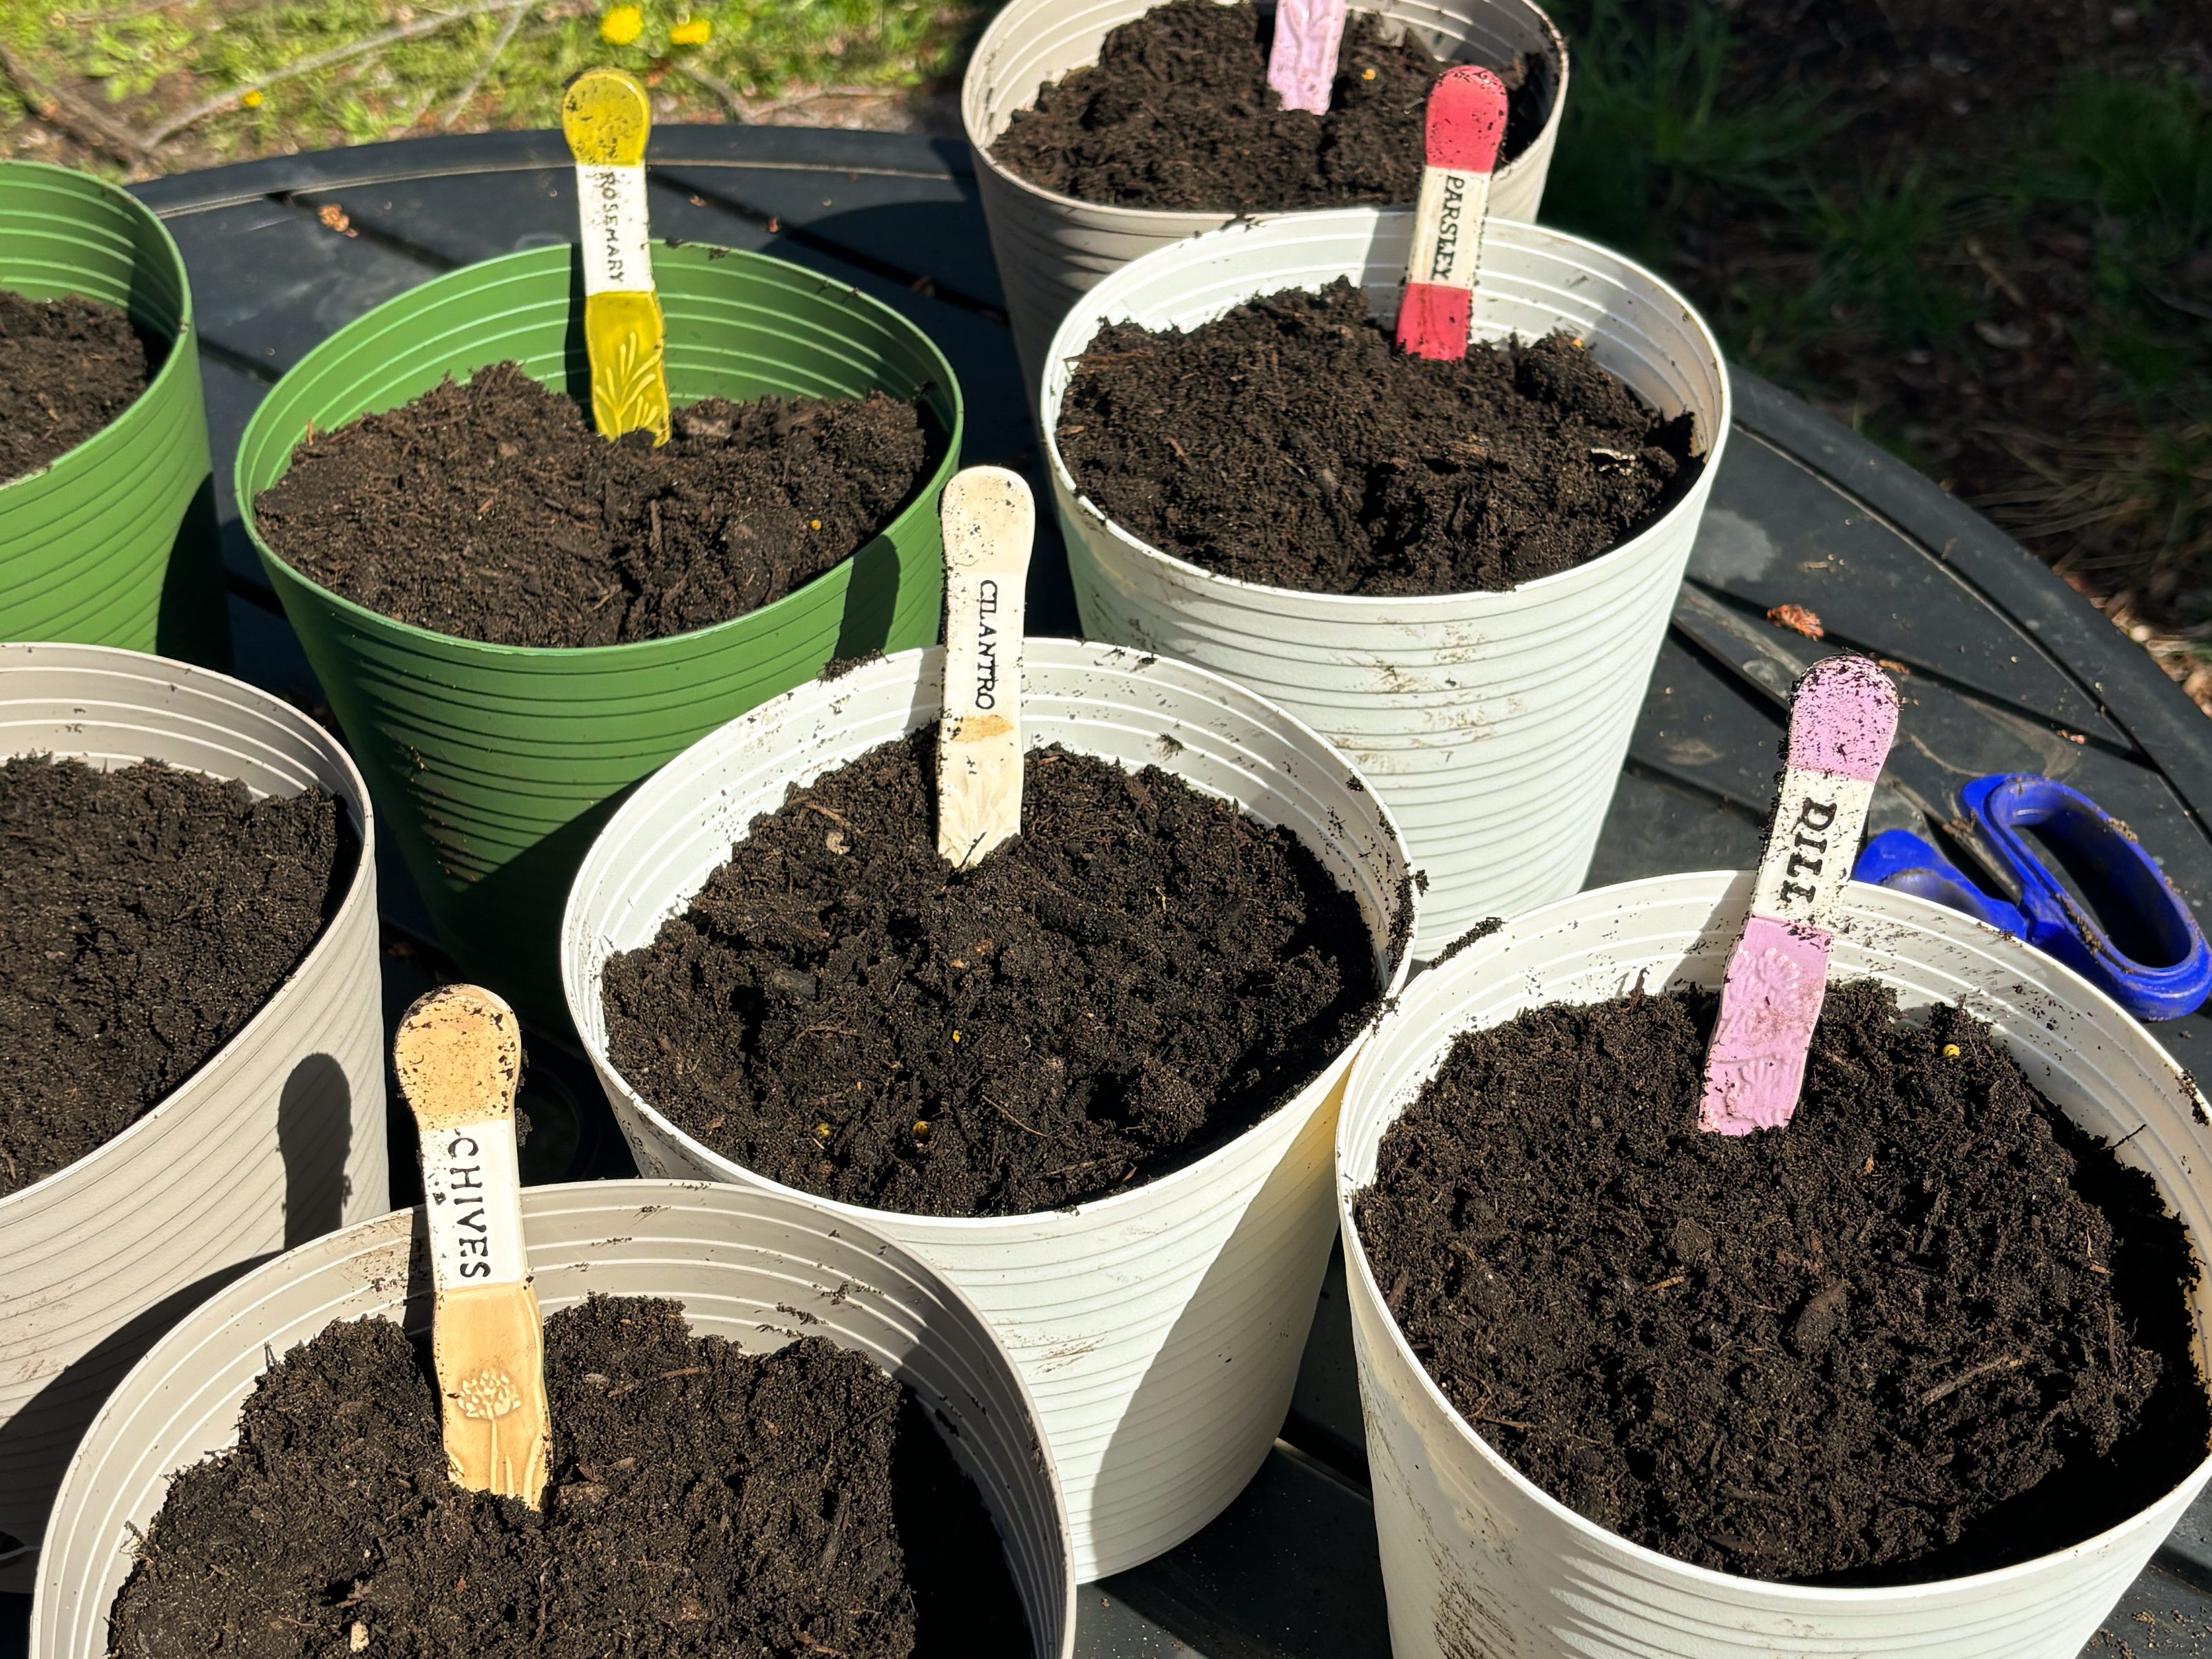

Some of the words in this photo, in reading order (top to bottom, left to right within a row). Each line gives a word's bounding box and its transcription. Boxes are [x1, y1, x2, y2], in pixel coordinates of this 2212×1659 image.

[598, 171, 624, 283] ROSEMARY
[1430, 175, 1465, 281] PARSLEY
[975, 580, 998, 710] CILANTRO
[1780, 796, 1837, 904] DILL
[447, 1137, 491, 1278] CHIVES
